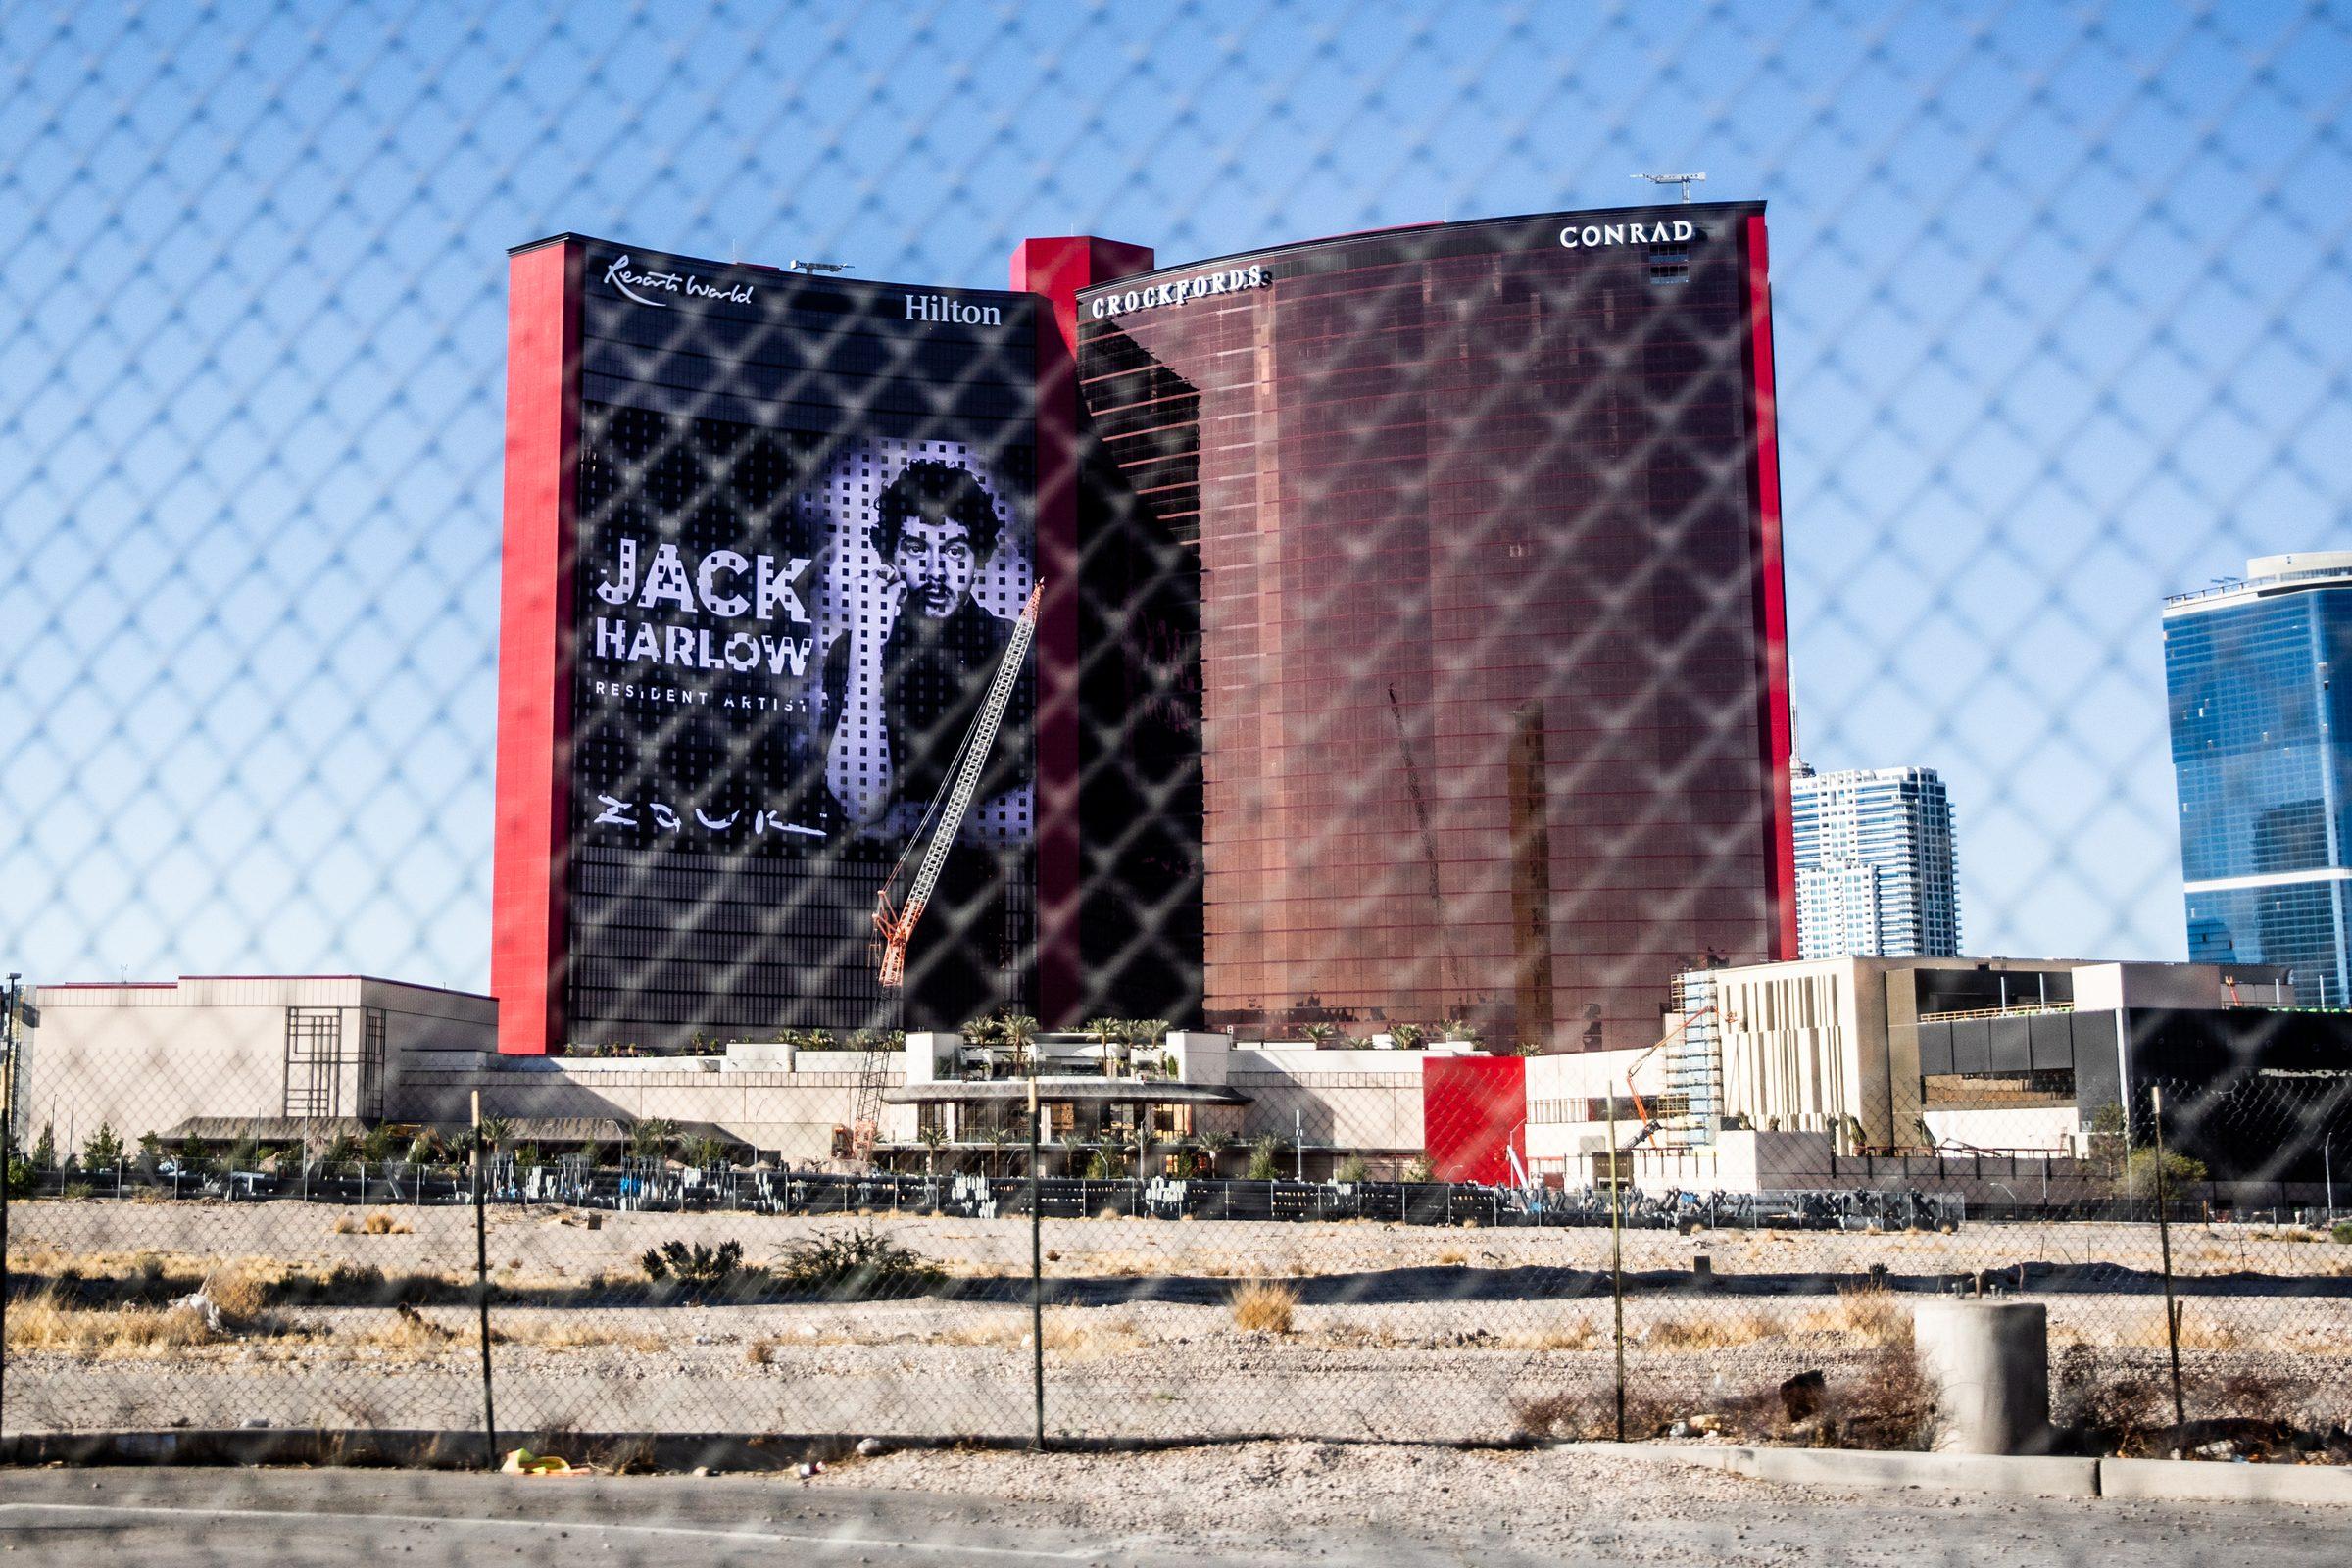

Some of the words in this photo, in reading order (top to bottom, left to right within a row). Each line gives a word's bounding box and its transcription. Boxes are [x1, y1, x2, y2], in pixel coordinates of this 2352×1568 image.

[1559, 220, 1693, 248] CONRAD
[604, 255, 683, 307] Resorts
[686, 275, 754, 304] World
[1092, 264, 1262, 319] CROCKFORDS
[905, 294, 1001, 325] Hilton
[596, 537, 812, 624] JACK
[596, 616, 814, 676] HARLOW
[596, 681, 708, 705] RESIDENT
[723, 695, 807, 713] ARTIST
